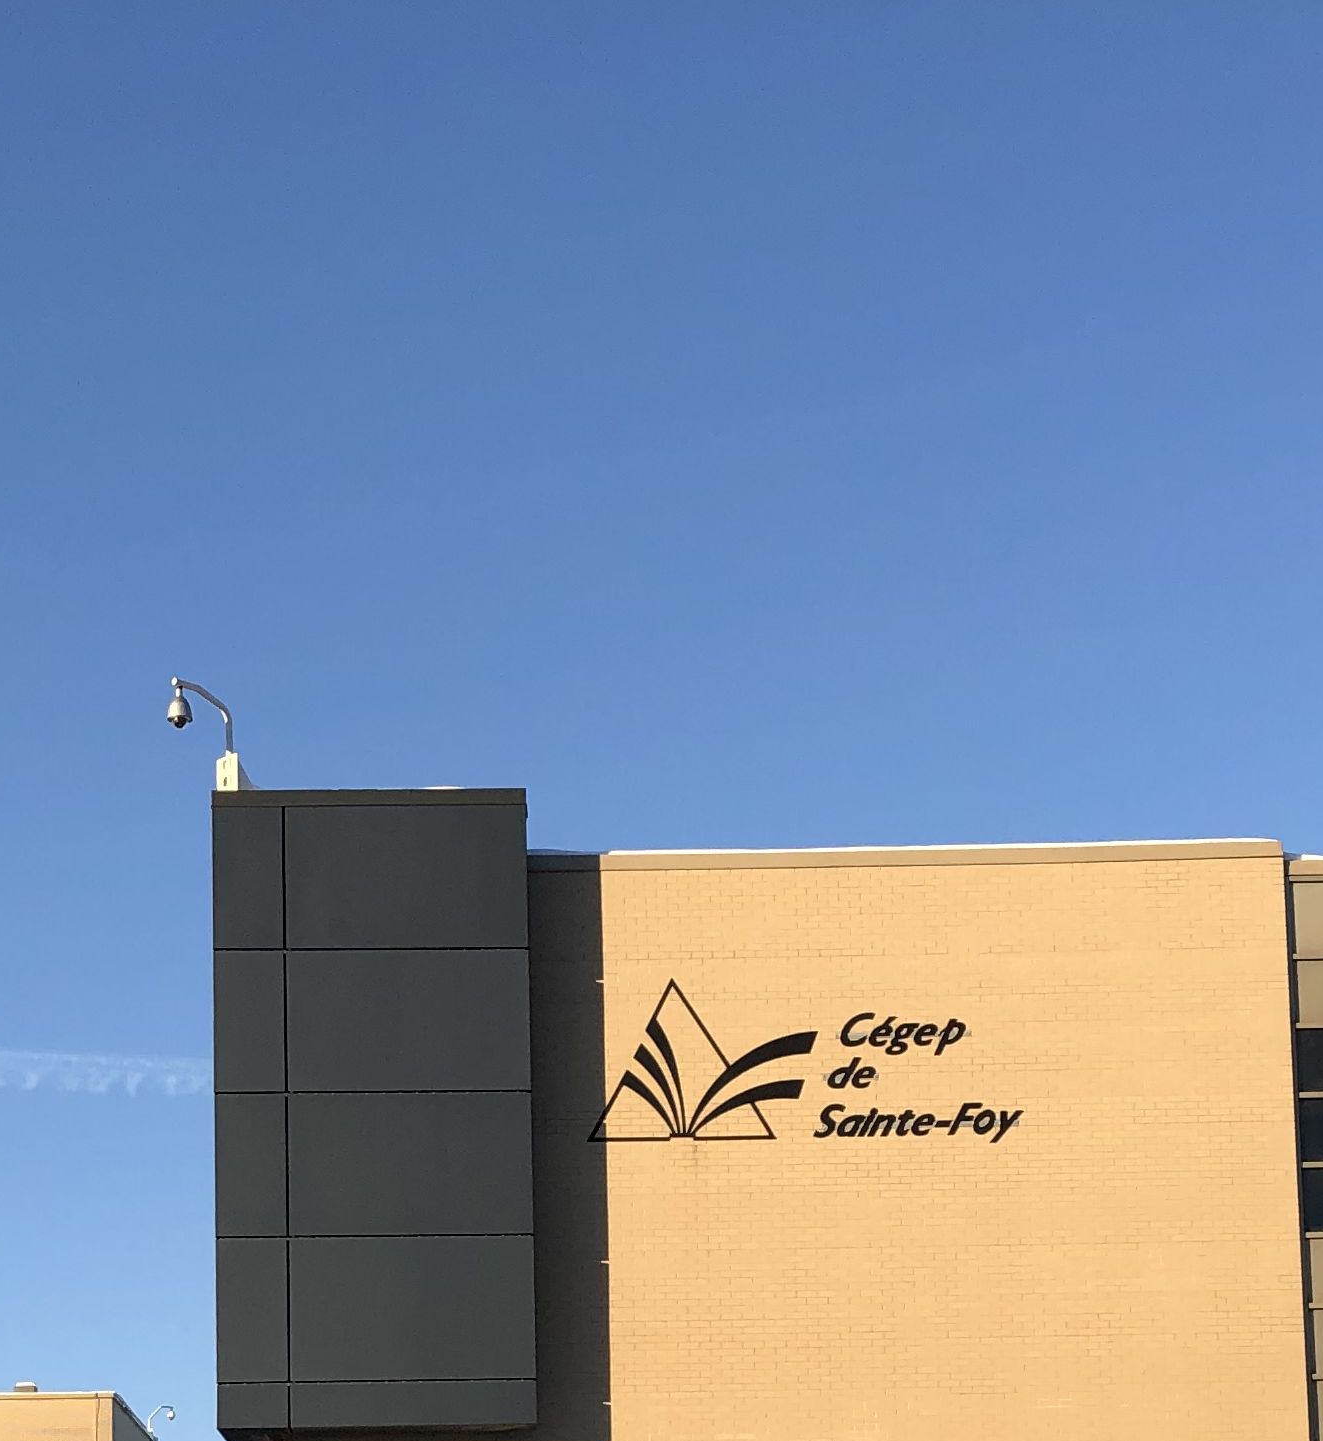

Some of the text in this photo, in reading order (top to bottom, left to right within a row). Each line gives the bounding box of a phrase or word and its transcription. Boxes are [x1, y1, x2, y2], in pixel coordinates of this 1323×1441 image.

[838, 1012, 967, 1056] Cégep
[826, 1057, 877, 1089] de
[813, 1103, 1025, 1144] Sainte-Foy
